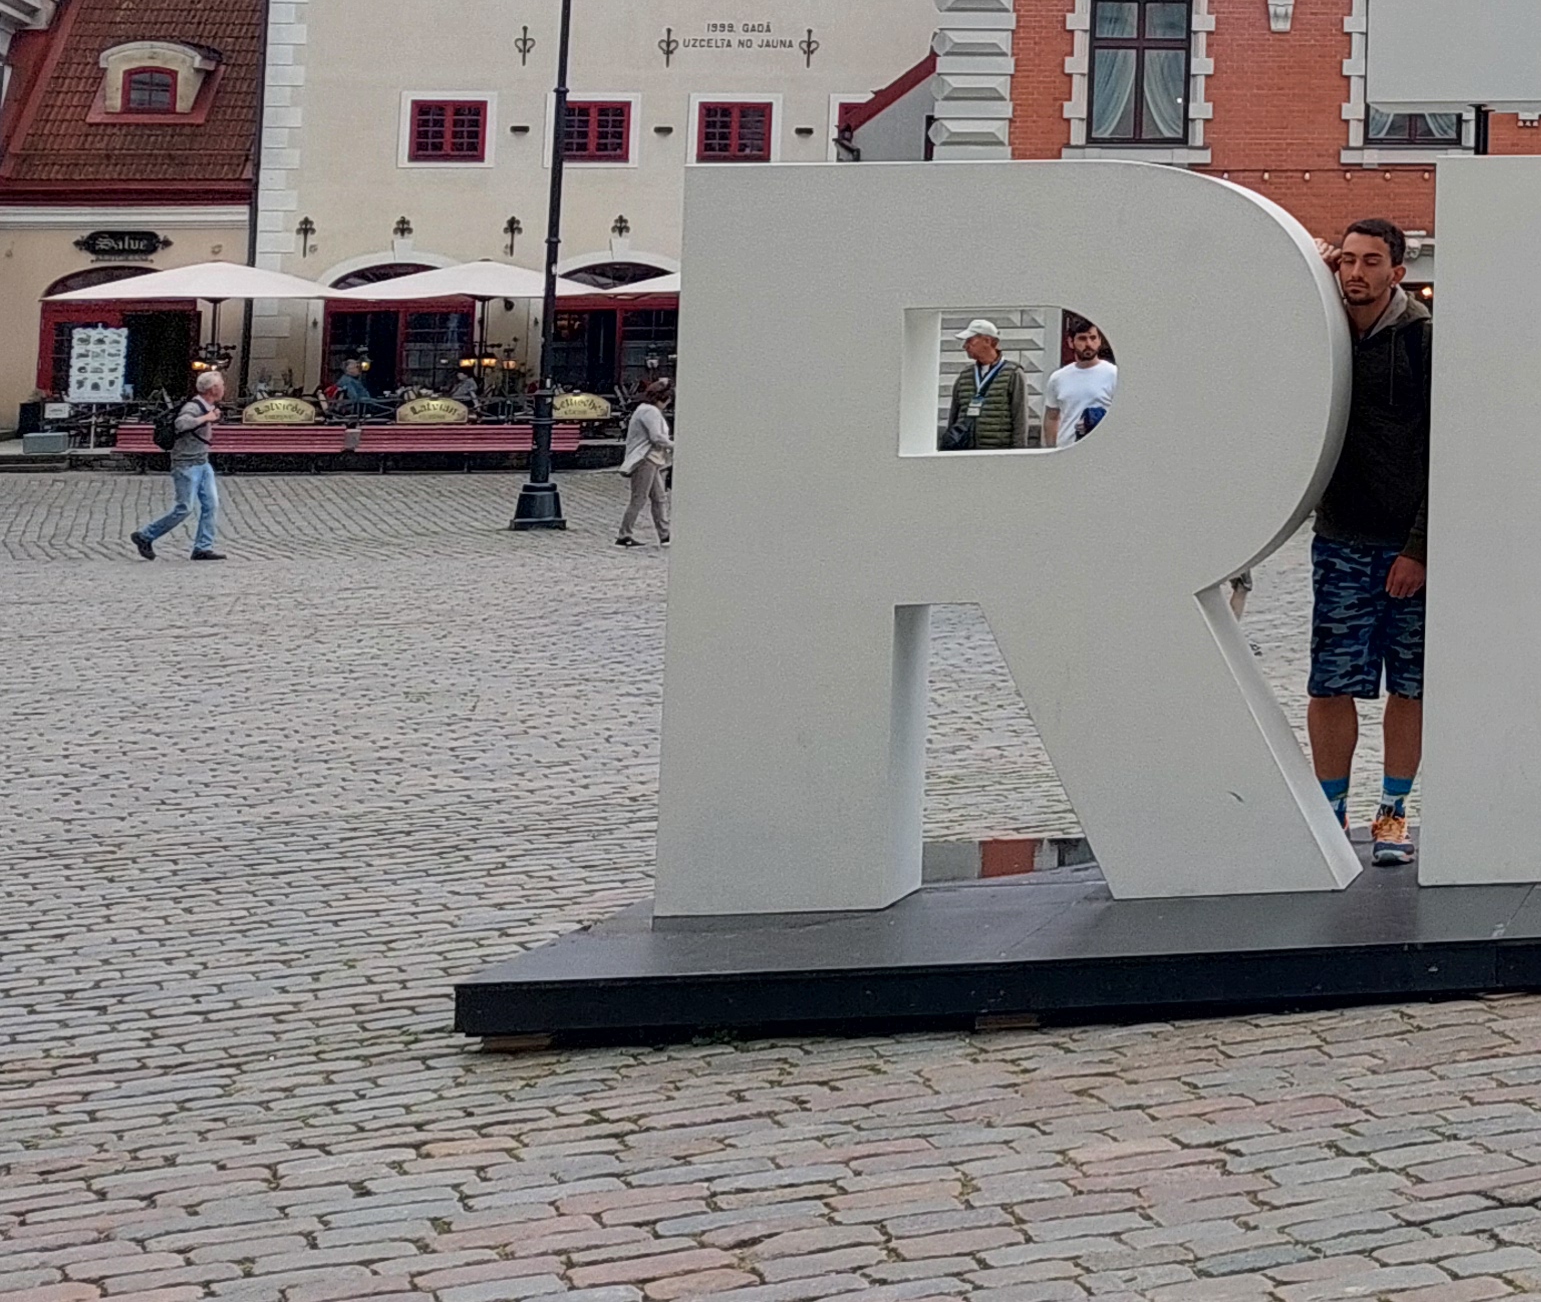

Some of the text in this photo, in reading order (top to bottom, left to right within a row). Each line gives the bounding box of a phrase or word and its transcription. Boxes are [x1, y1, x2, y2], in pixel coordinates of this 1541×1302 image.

[706, 21, 772, 34] 1999. GADĀ
[737, 39, 753, 49] NO
[757, 39, 794, 49] JAUNA
